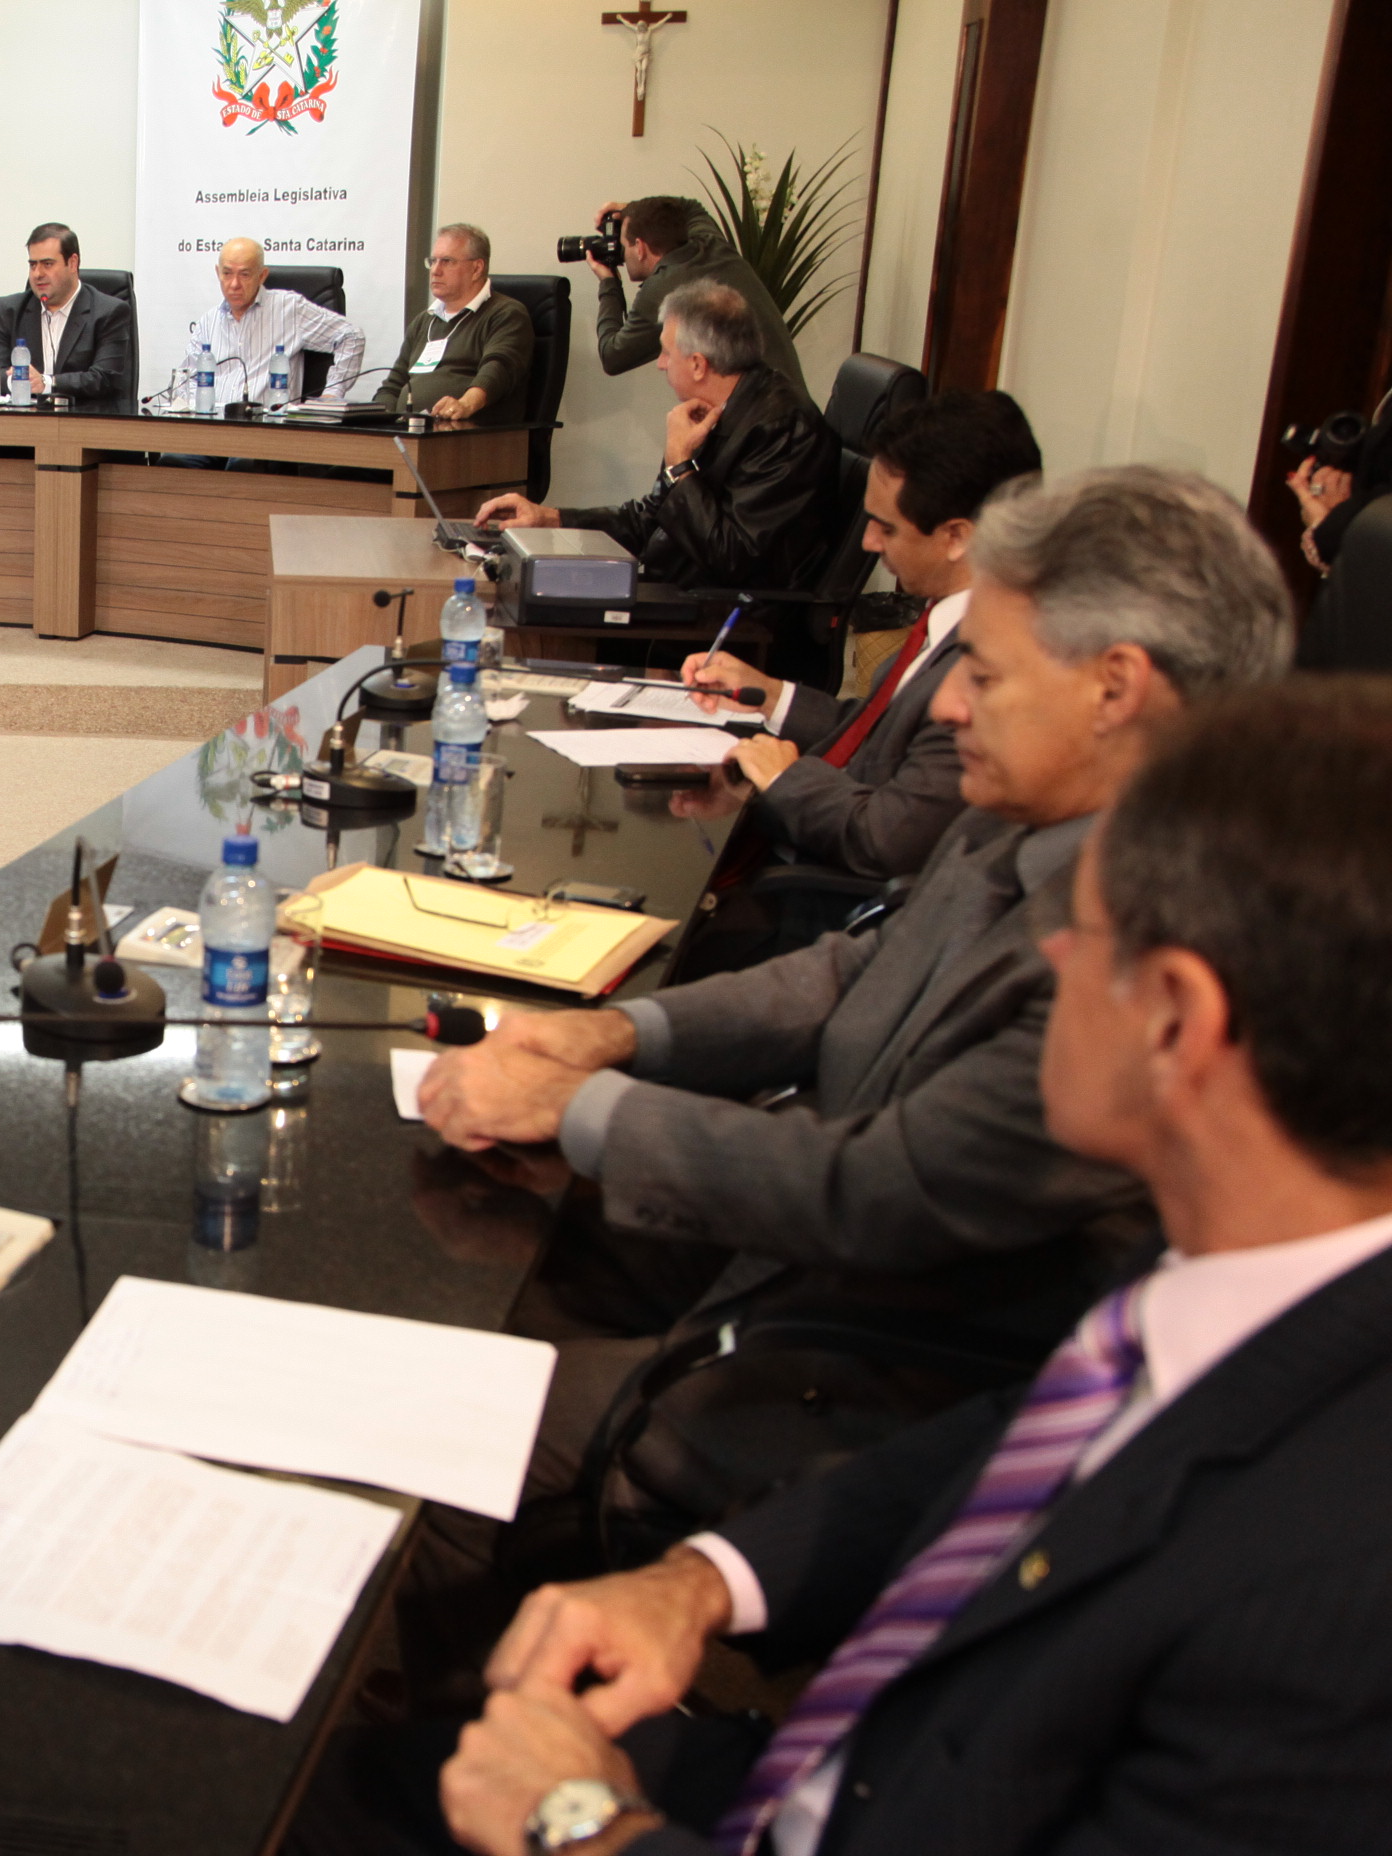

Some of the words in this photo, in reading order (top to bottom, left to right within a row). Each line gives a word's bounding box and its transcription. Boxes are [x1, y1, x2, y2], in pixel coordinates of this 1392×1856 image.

[222, 104, 251, 117] ESTADO
[251, 109, 262, 120] DE
[291, 99, 324, 114] CATARINA
[195, 189, 269, 203] Assembleia
[274, 187, 348, 205] Legislativa
[178, 239, 192, 252] do
[196, 239, 225, 252] Esta
[263, 238, 302, 252] Santa
[306, 238, 365, 251] Catarina
